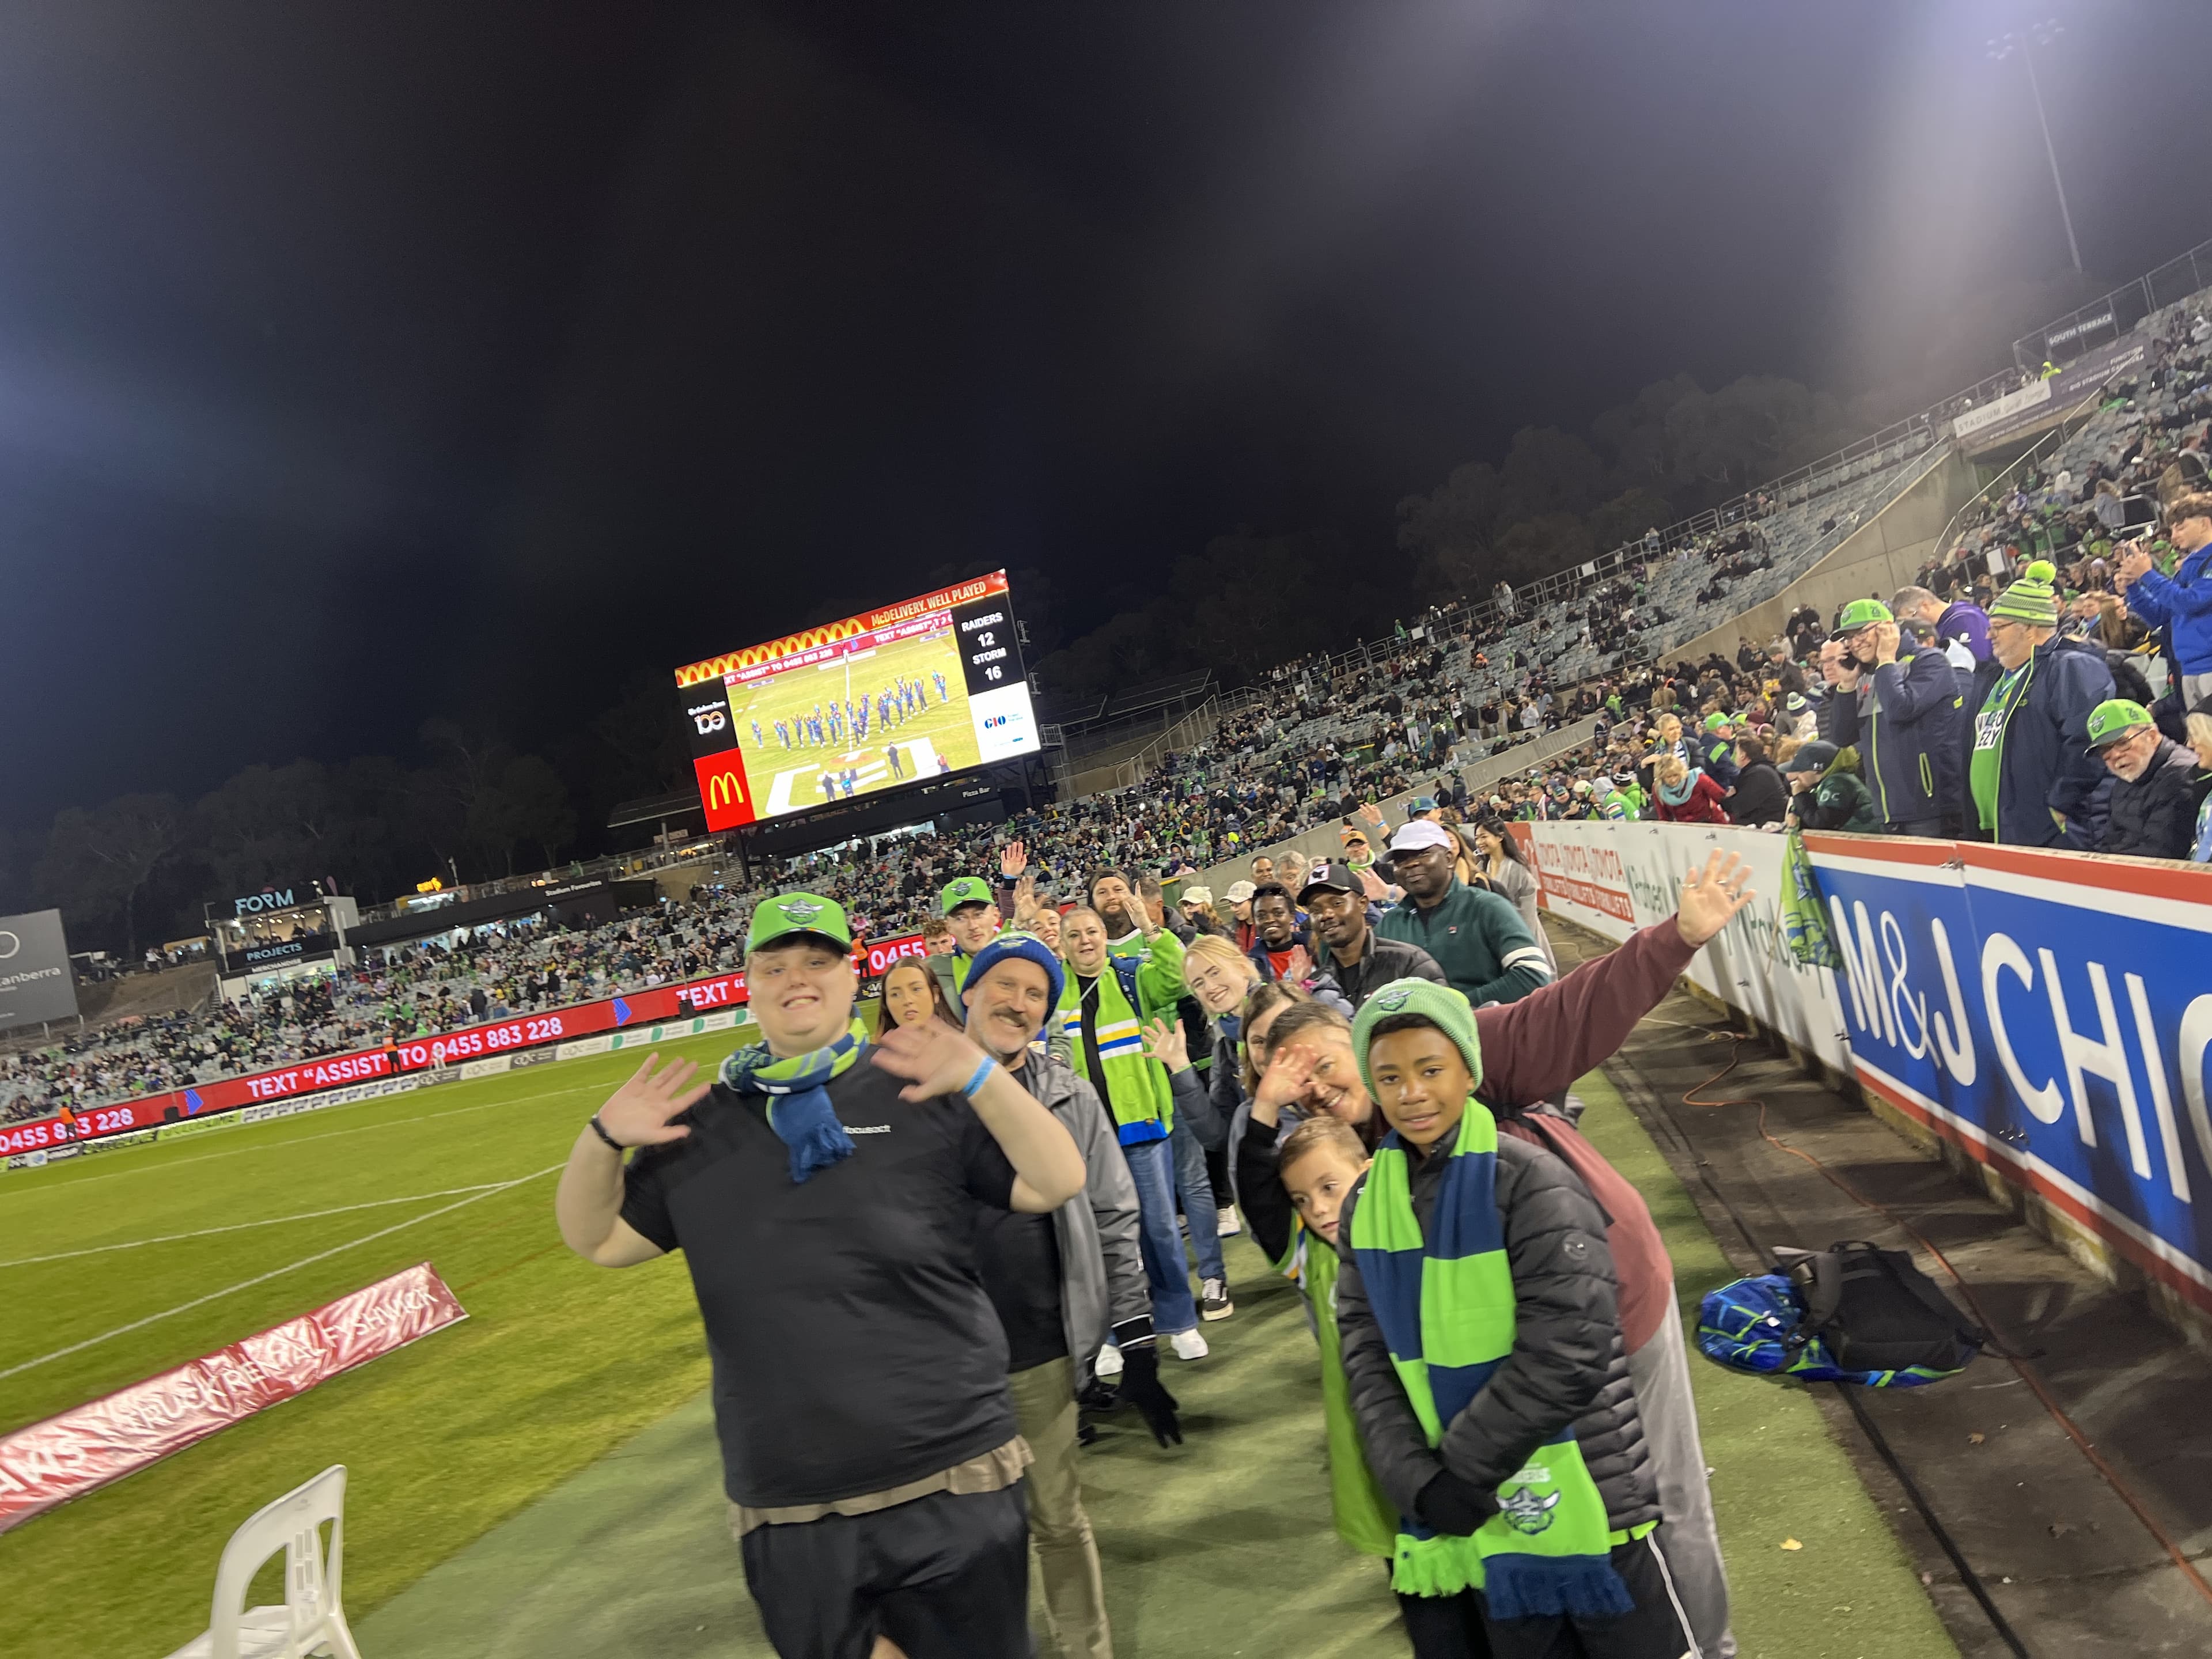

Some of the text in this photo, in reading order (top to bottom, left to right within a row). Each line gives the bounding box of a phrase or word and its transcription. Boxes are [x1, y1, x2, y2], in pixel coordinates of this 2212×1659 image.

[2048, 312, 2112, 345] SOUTH TERRACE
[1958, 407, 2002, 433] STADIUM
[871, 581, 987, 627] McDELIVERY. WELL PLAYED
[961, 612, 1003, 632] RAIDERS
[978, 632, 995, 647] 12
[972, 647, 1007, 665] STORM
[985, 665, 1002, 680] 16
[984, 715, 1006, 729] GIO
[962, 786, 991, 798] Pizza Bar
[234, 888, 294, 915] FORM
[545, 886, 571, 897] Stadium
[246, 942, 302, 961] PROJECTS
[0, 967, 61, 986] anberra
[1830, 895, 1976, 1086] M&J
[247, 1071, 299, 1098] TEXT
[397, 1045, 427, 1066] TO
[431, 1033, 483, 1060] 0455
[486, 1025, 523, 1048] 883
[526, 1017, 564, 1040] 228
[53, 1116, 92, 1140] 83
[96, 1108, 135, 1131] 228
[322, 1285, 438, 1349] FYSHWICK
